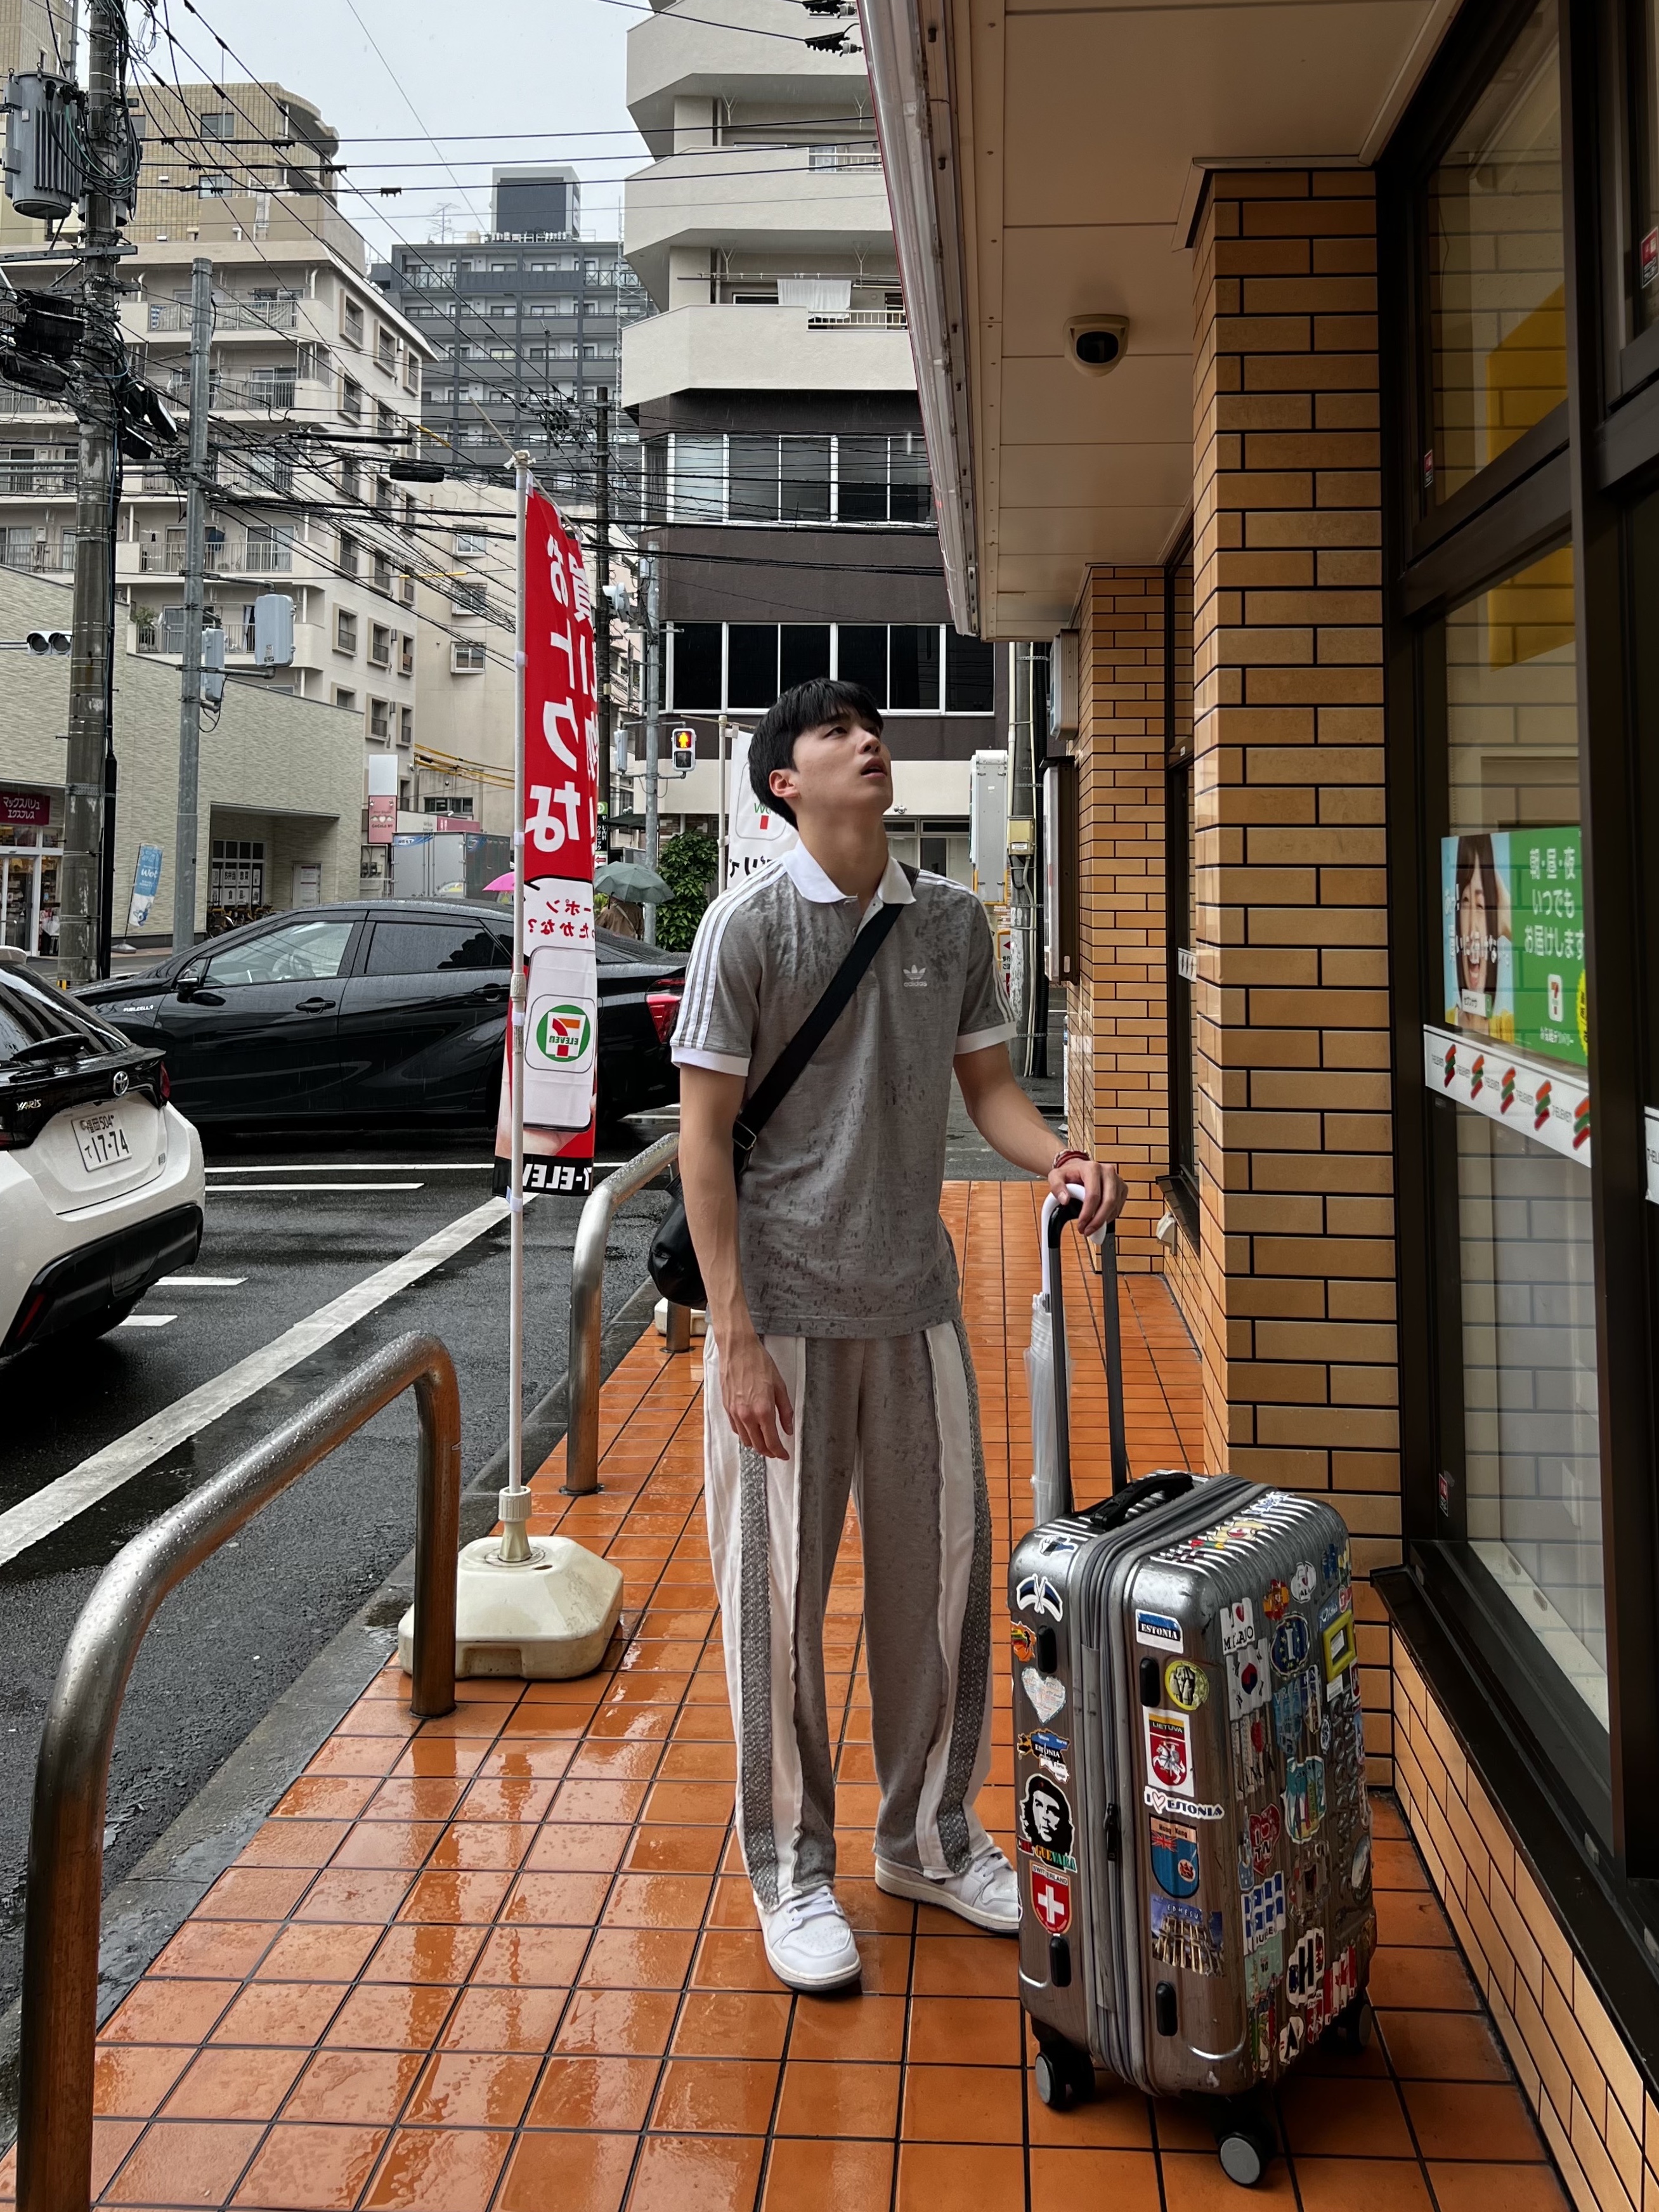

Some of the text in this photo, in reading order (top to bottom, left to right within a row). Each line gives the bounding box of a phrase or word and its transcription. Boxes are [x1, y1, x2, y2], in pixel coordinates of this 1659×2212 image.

[3, 796, 41, 810] マックスバリュ
[8, 809, 35, 819] エクスプレス
[1532, 887, 1575, 919] いつでも
[1524, 925, 1585, 961] お届けします
[16, 1098, 42, 1112] YARIS
[100, 1114, 114, 1130] 504
[1140, 1623, 1179, 1641] ESTONIA
[1152, 1721, 1184, 1734] LIETUVA
[1167, 1800, 1223, 1817] ESTONIA
[1159, 1823, 1188, 1839] Hong Kong
[1034, 1844, 1077, 1871] GUEVARA
